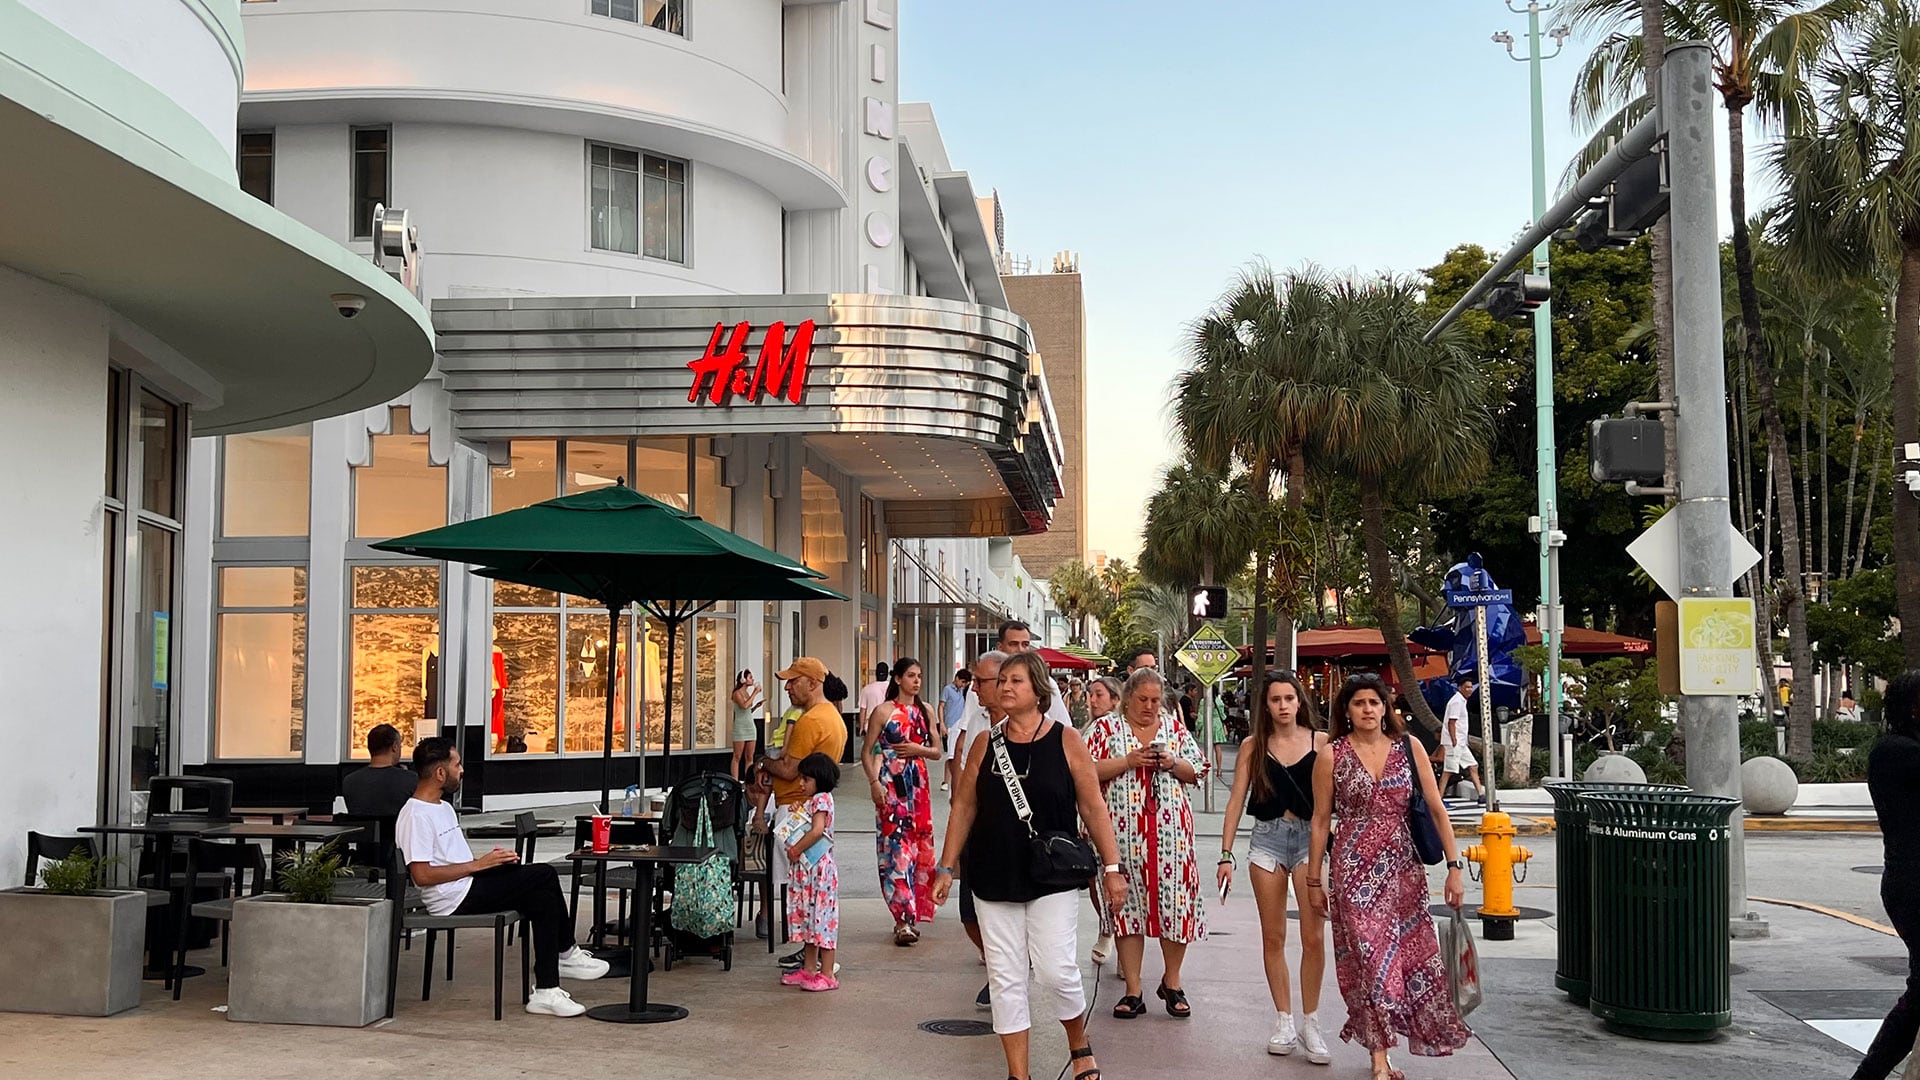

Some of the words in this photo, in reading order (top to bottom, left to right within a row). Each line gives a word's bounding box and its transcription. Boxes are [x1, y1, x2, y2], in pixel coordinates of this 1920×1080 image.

[687, 319, 815, 406] H&M
[1453, 594, 1501, 603] Pennsylvania
[1605, 825, 1612, 835] &
[1613, 827, 1666, 840] Aluminum
[1668, 830, 1697, 841] Cans
